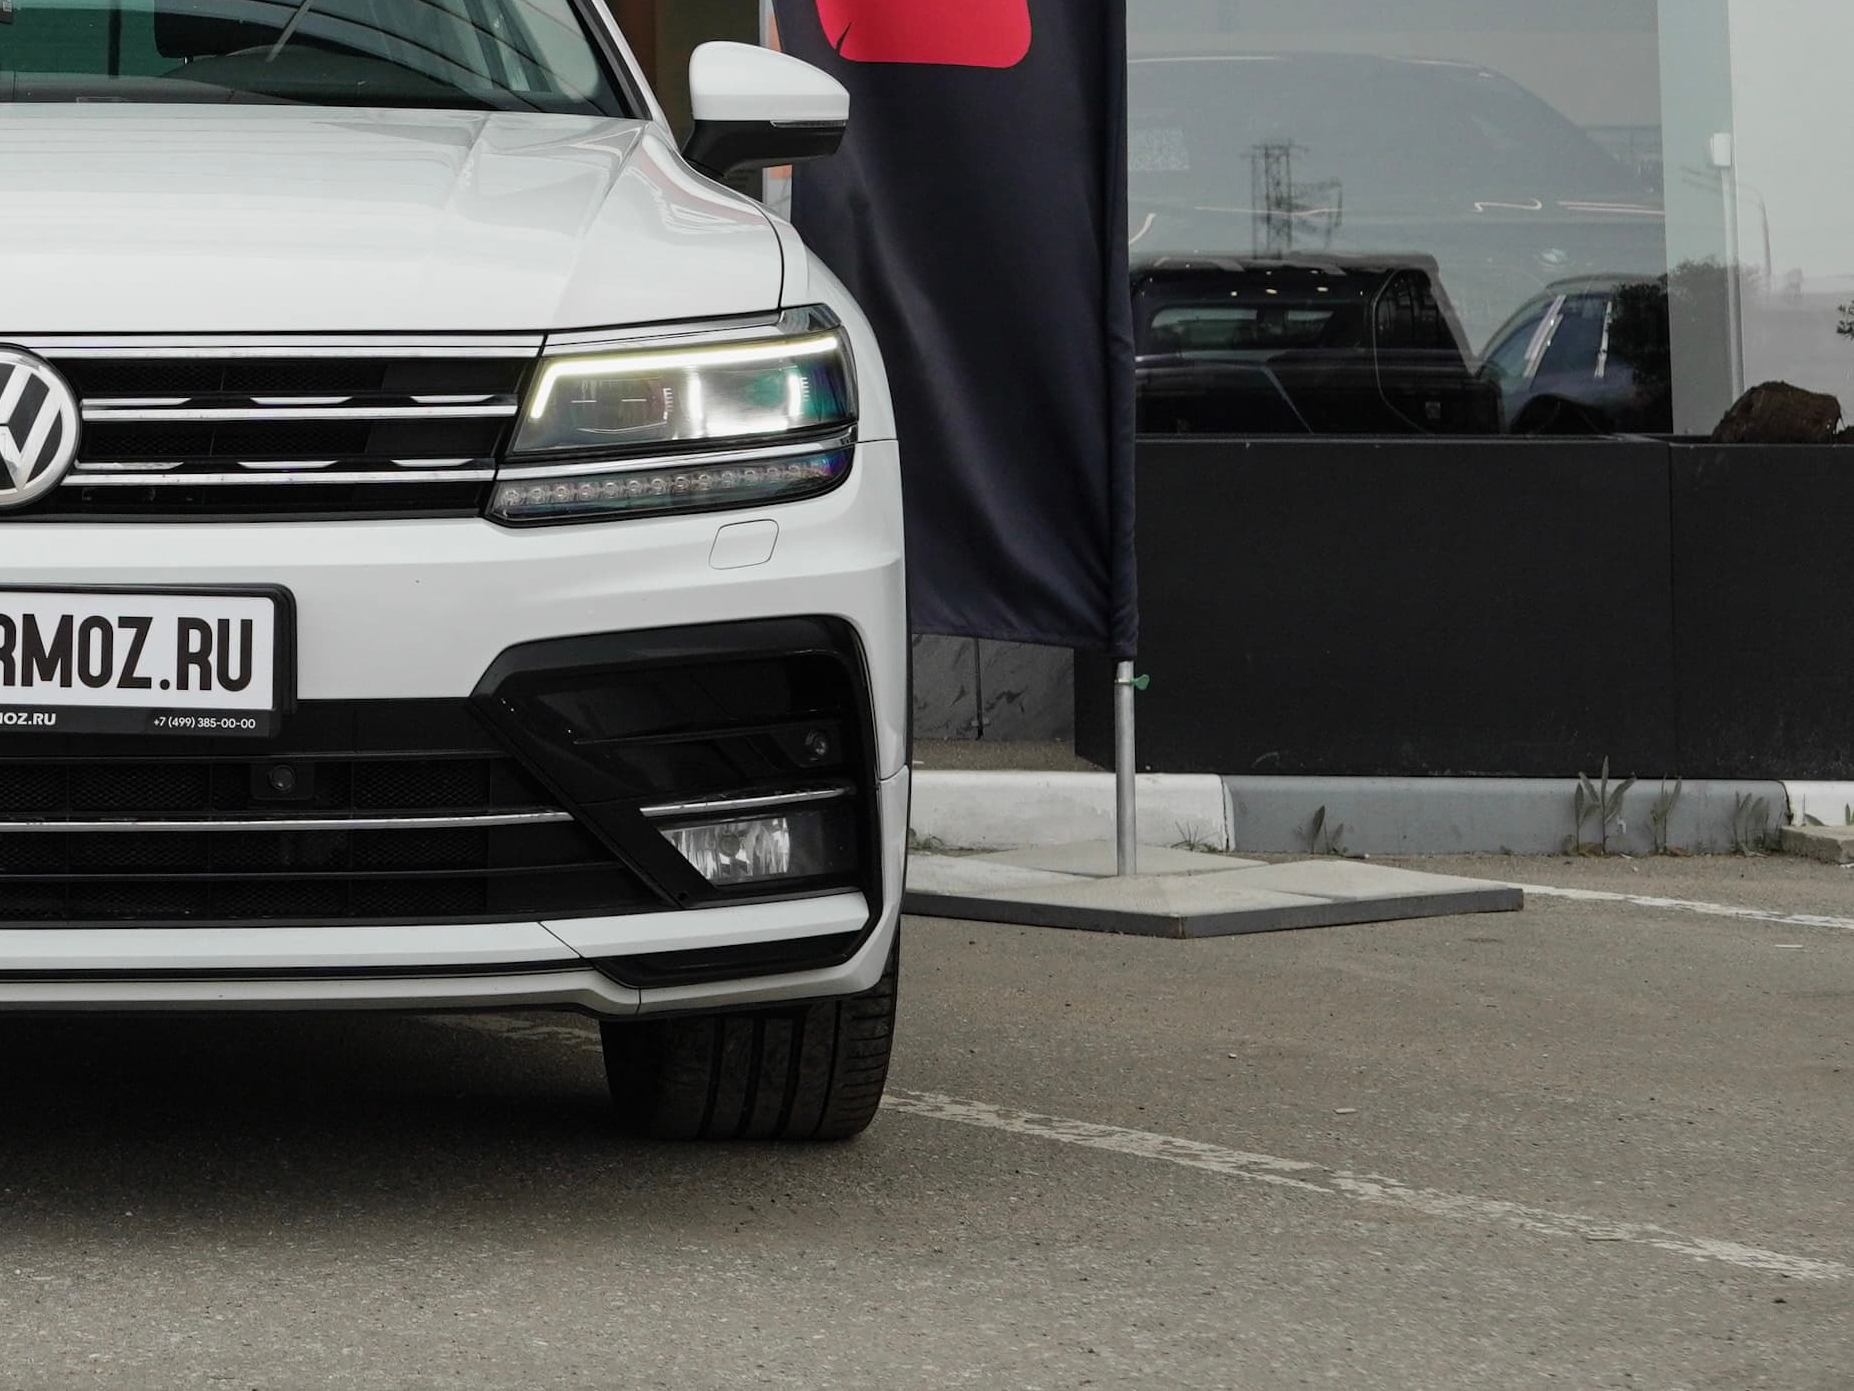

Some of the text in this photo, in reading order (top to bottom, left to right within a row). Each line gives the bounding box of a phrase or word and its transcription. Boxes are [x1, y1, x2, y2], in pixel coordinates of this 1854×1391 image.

[154, 716, 256, 729] +7 (499) 385-00-00
